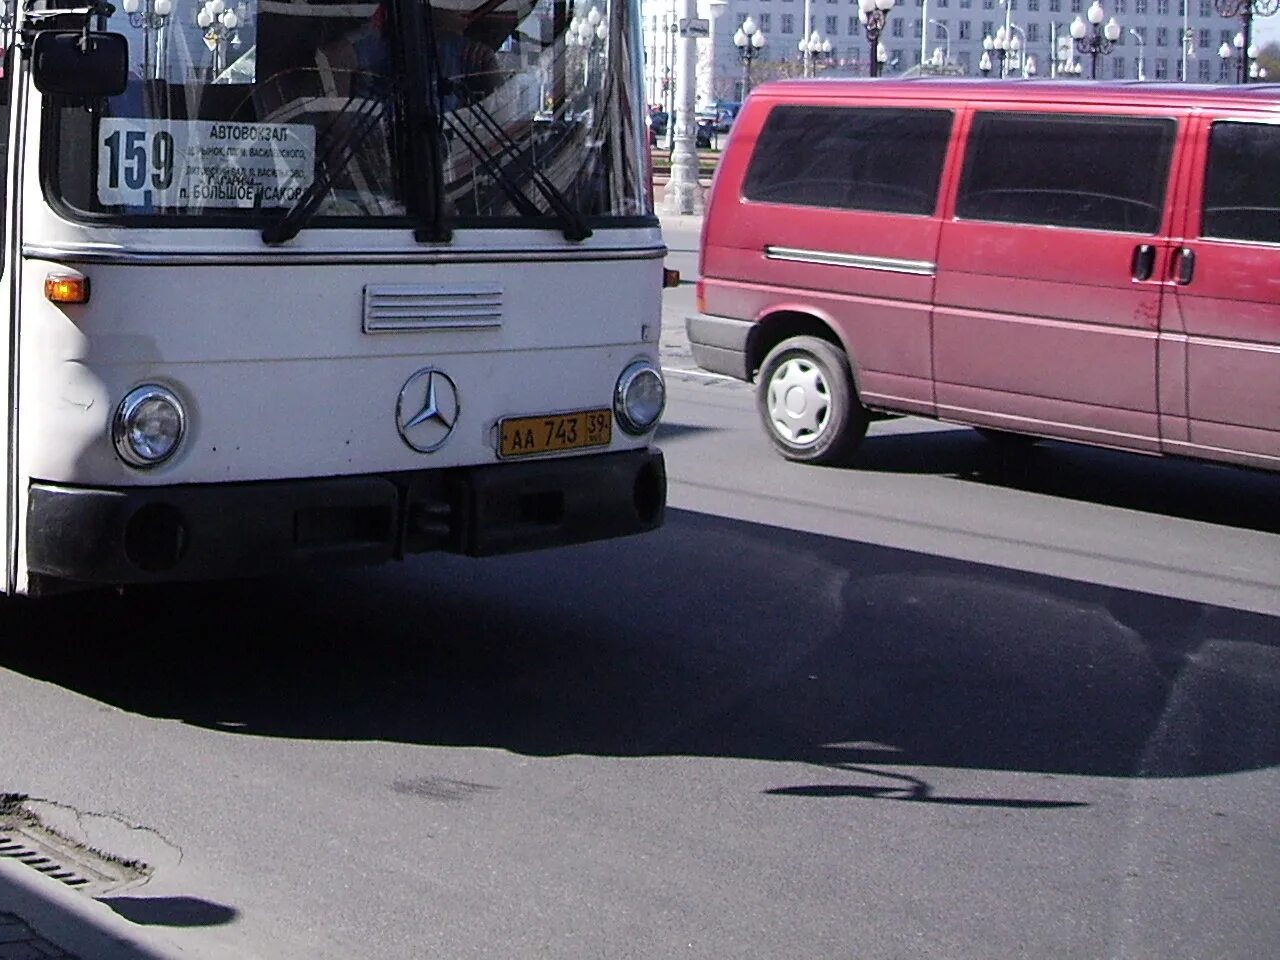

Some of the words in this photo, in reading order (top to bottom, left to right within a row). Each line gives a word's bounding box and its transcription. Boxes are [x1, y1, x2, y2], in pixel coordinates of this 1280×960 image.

[210, 125, 287, 141] АВТОВОКЗАЛ
[104, 130, 174, 190] 159
[193, 184, 254, 200] БОЛЬШОЕ
[543, 418, 578, 446] 743
[588, 414, 604, 433] 39
